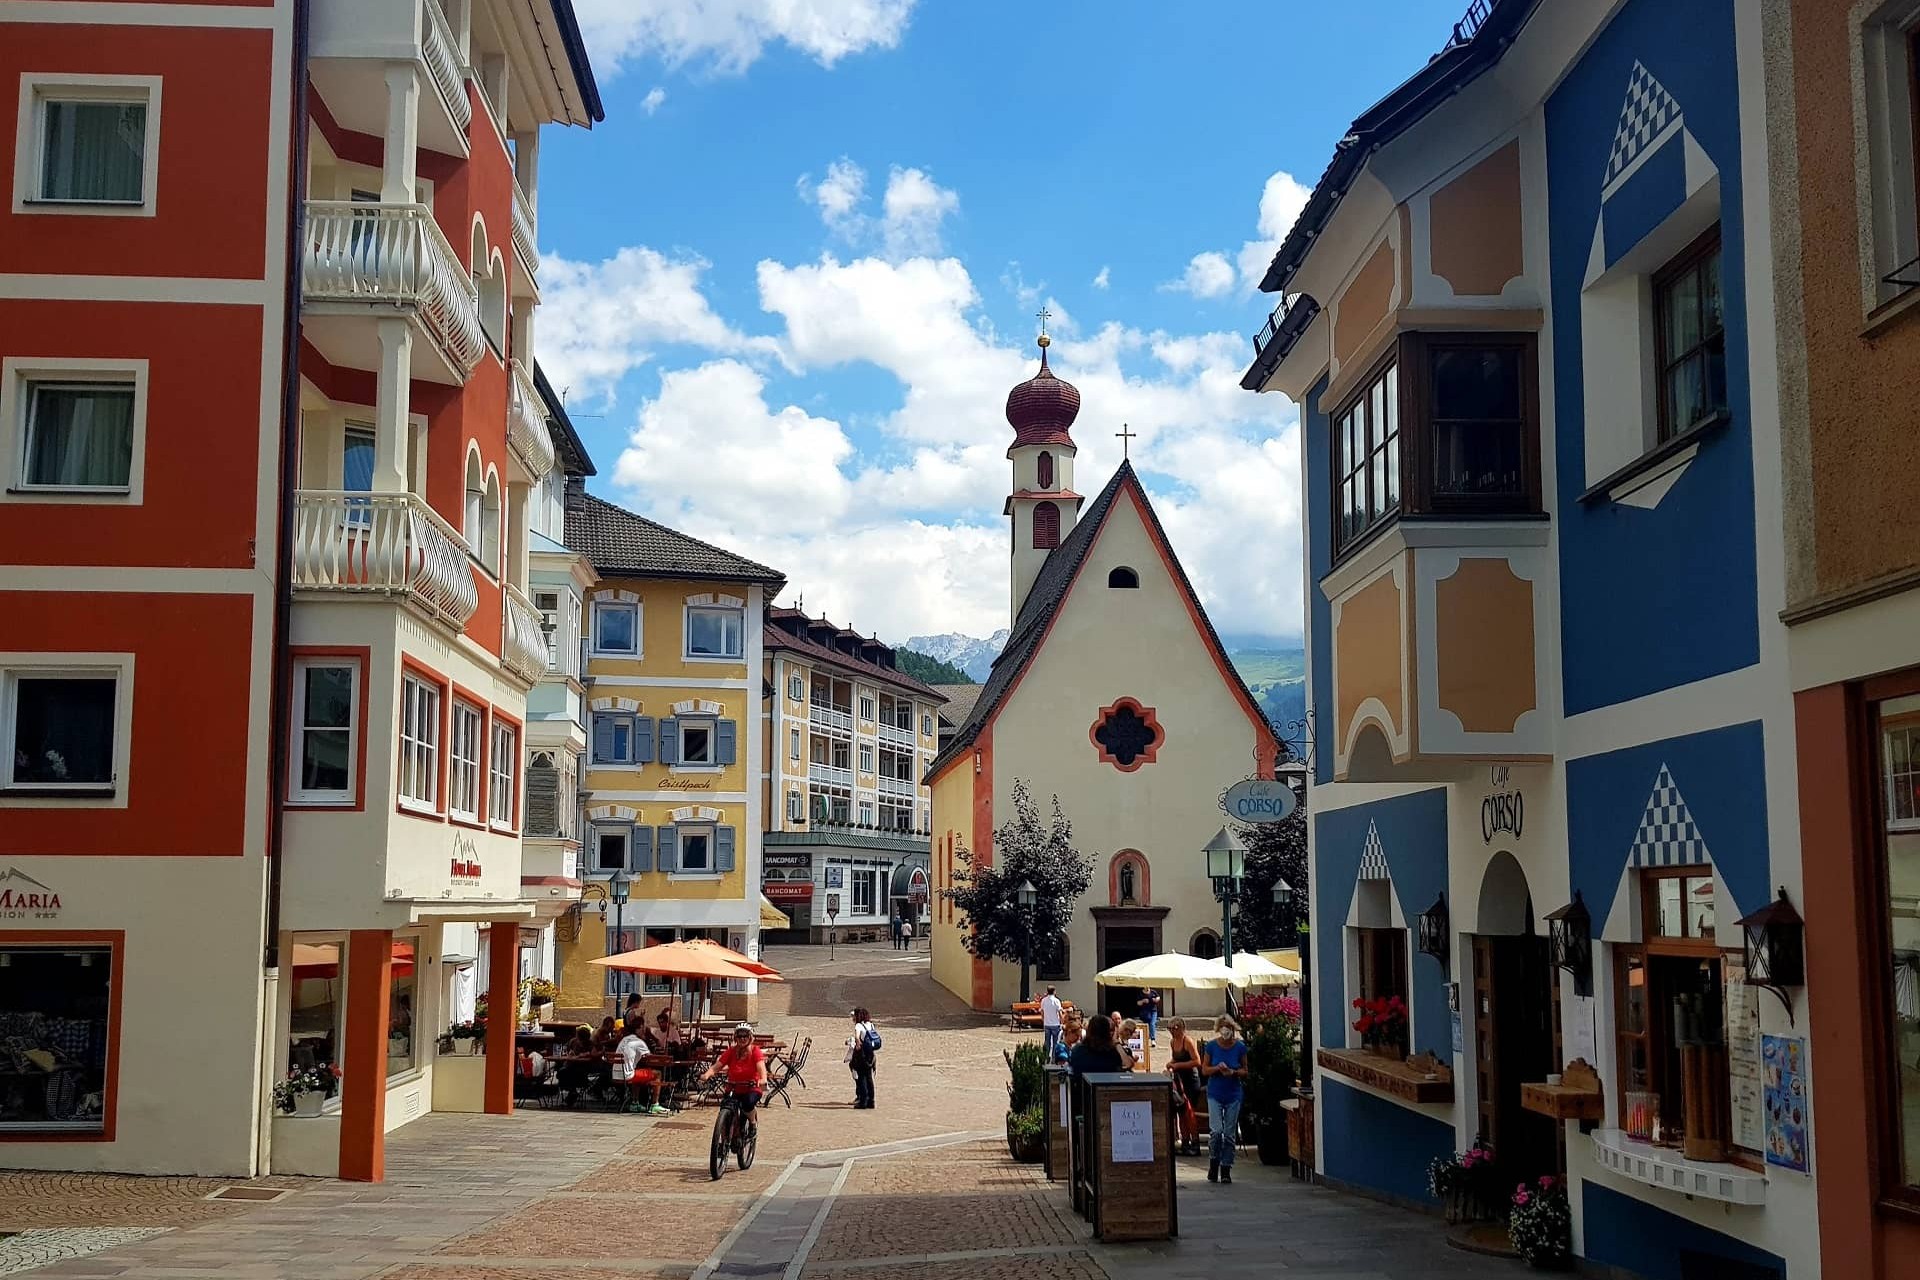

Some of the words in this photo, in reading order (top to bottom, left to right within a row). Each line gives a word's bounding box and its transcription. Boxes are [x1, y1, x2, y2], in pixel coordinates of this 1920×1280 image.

[1238, 798, 1283, 816] CORSO
[1481, 790, 1523, 845] CORSO
[0, 889, 61, 908] MARIA
